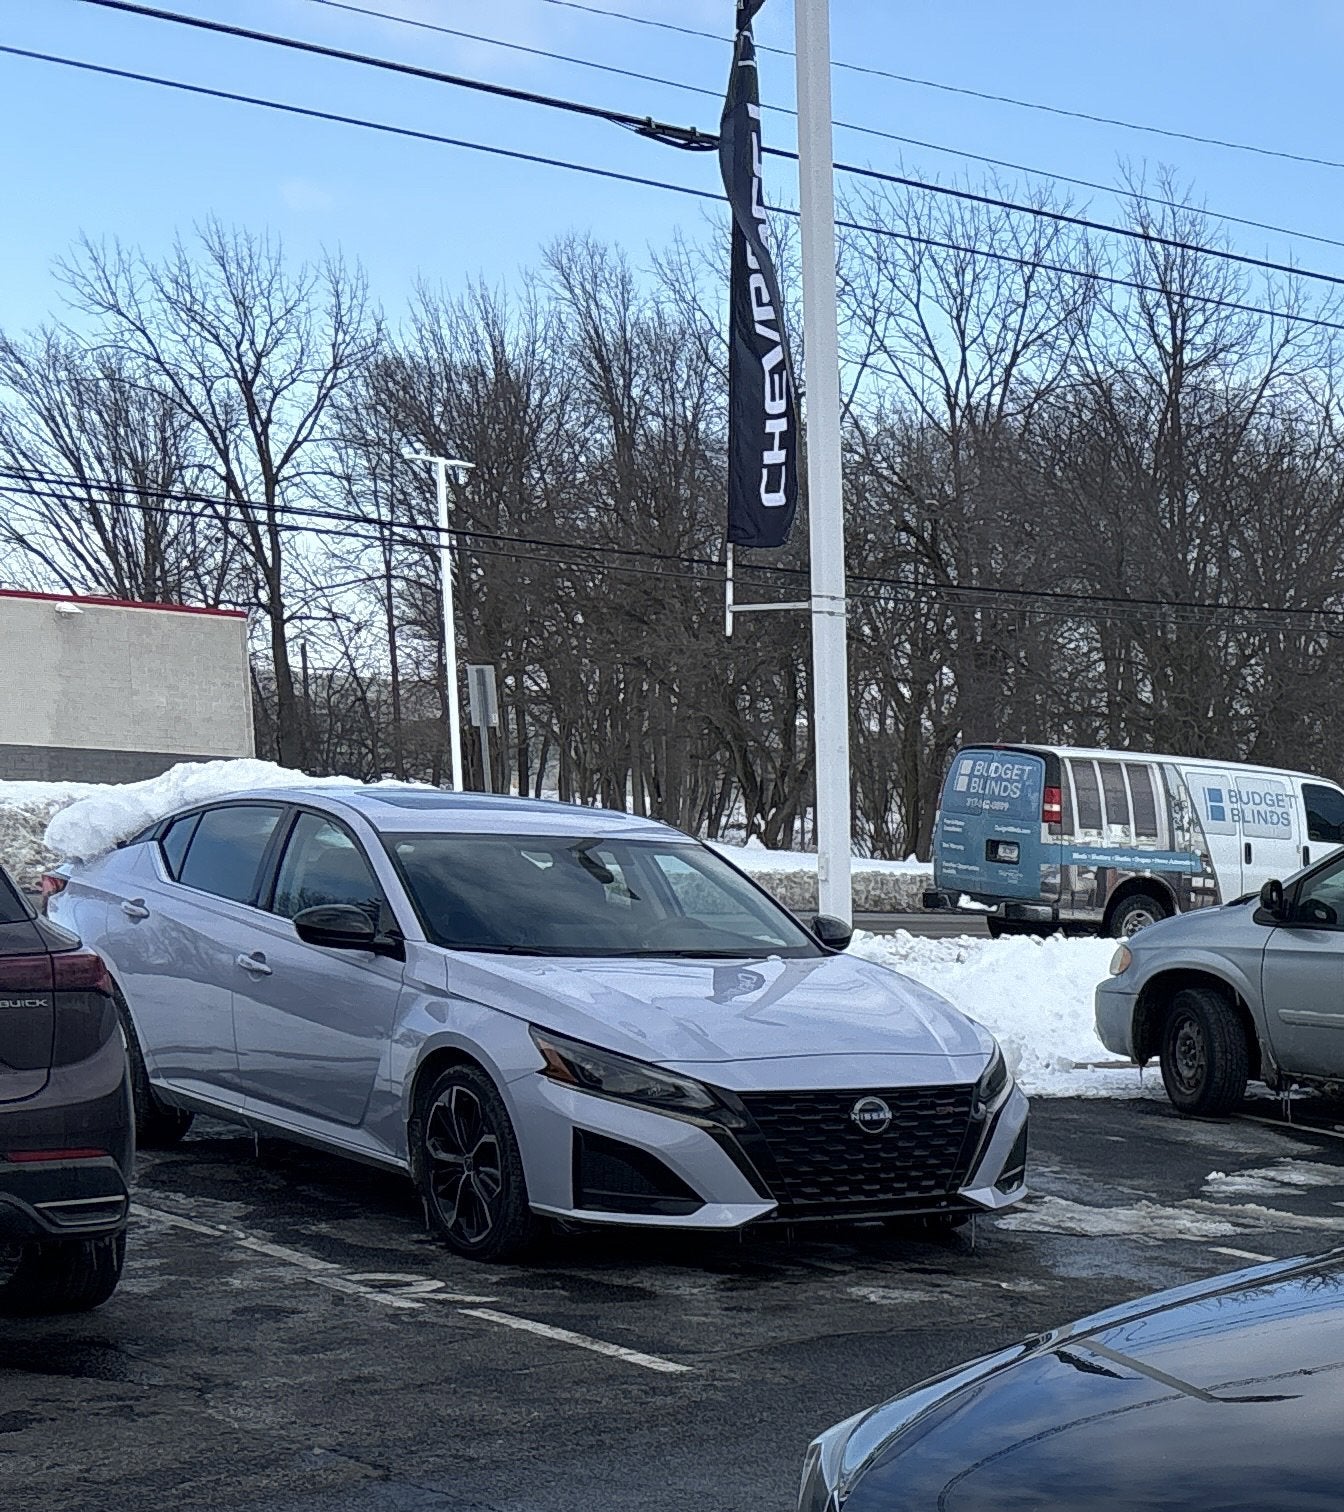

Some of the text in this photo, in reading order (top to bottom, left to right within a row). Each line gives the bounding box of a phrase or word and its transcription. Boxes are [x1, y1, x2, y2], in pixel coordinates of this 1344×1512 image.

[974, 761, 1032, 780] BUDGET
[970, 778, 1022, 798] BLINDS
[1228, 789, 1297, 809] BUDGET
[1231, 808, 1291, 826] BLINDS
[0, 999, 49, 1008] BUICK
[850, 1111, 893, 1121] NISSAN
